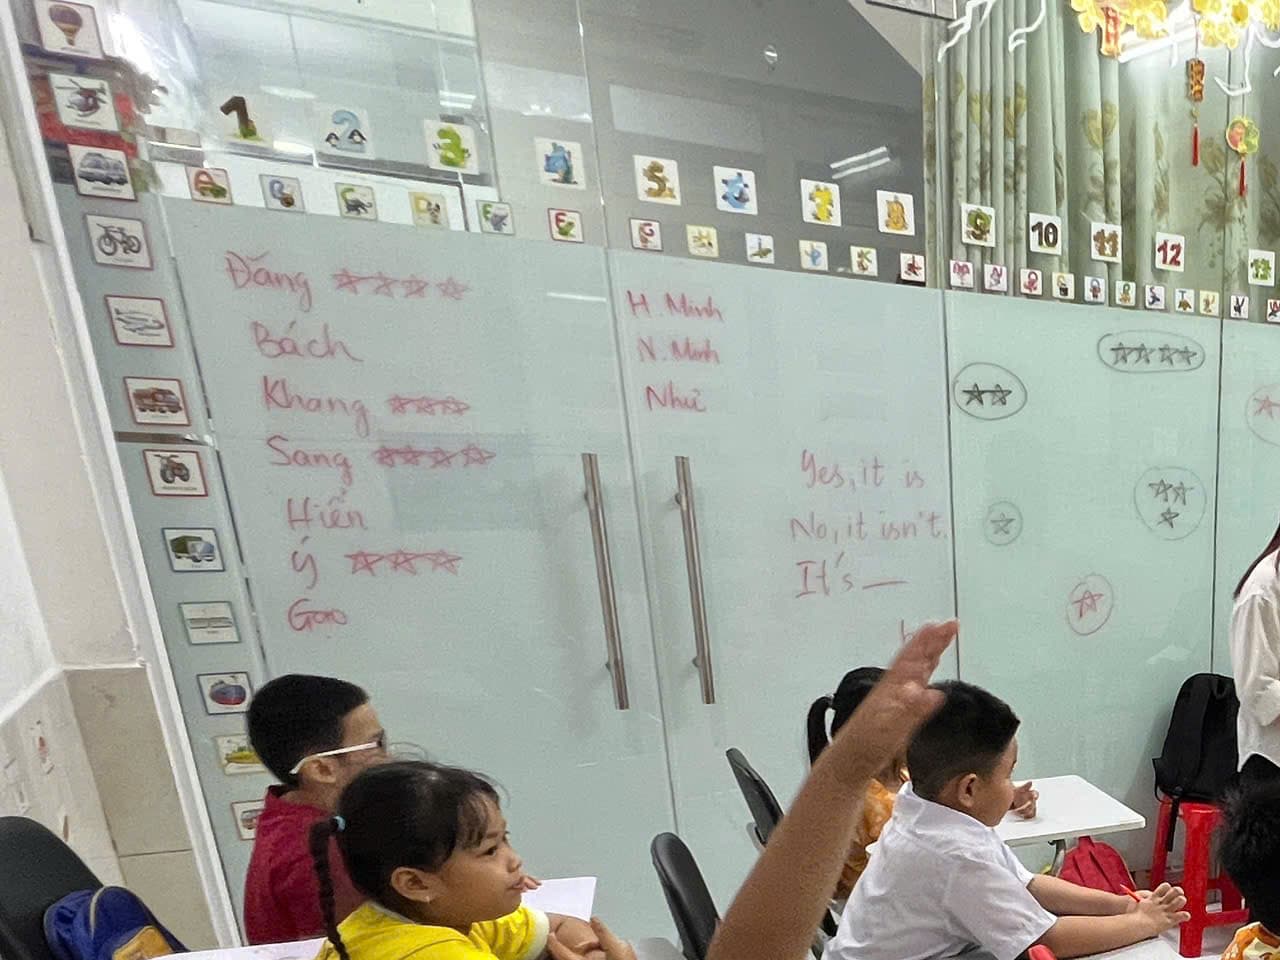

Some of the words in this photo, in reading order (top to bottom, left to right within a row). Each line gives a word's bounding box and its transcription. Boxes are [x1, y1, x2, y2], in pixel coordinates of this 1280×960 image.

[219, 96, 258, 140] 1
[331, 109, 366, 153] 2
[437, 125, 467, 168] 3
[644, 160, 676, 199] 5
[1031, 221, 1059, 248] 10
[1093, 228, 1118, 257] 11
[1157, 239, 1182, 267] 12
[665, 292, 724, 323] Minh
[251, 320, 363, 362] Bách
[263, 375, 369, 438] Khang
[266, 435, 353, 487] Sang
[902, 459, 925, 488] is
[796, 551, 854, 598] It's
